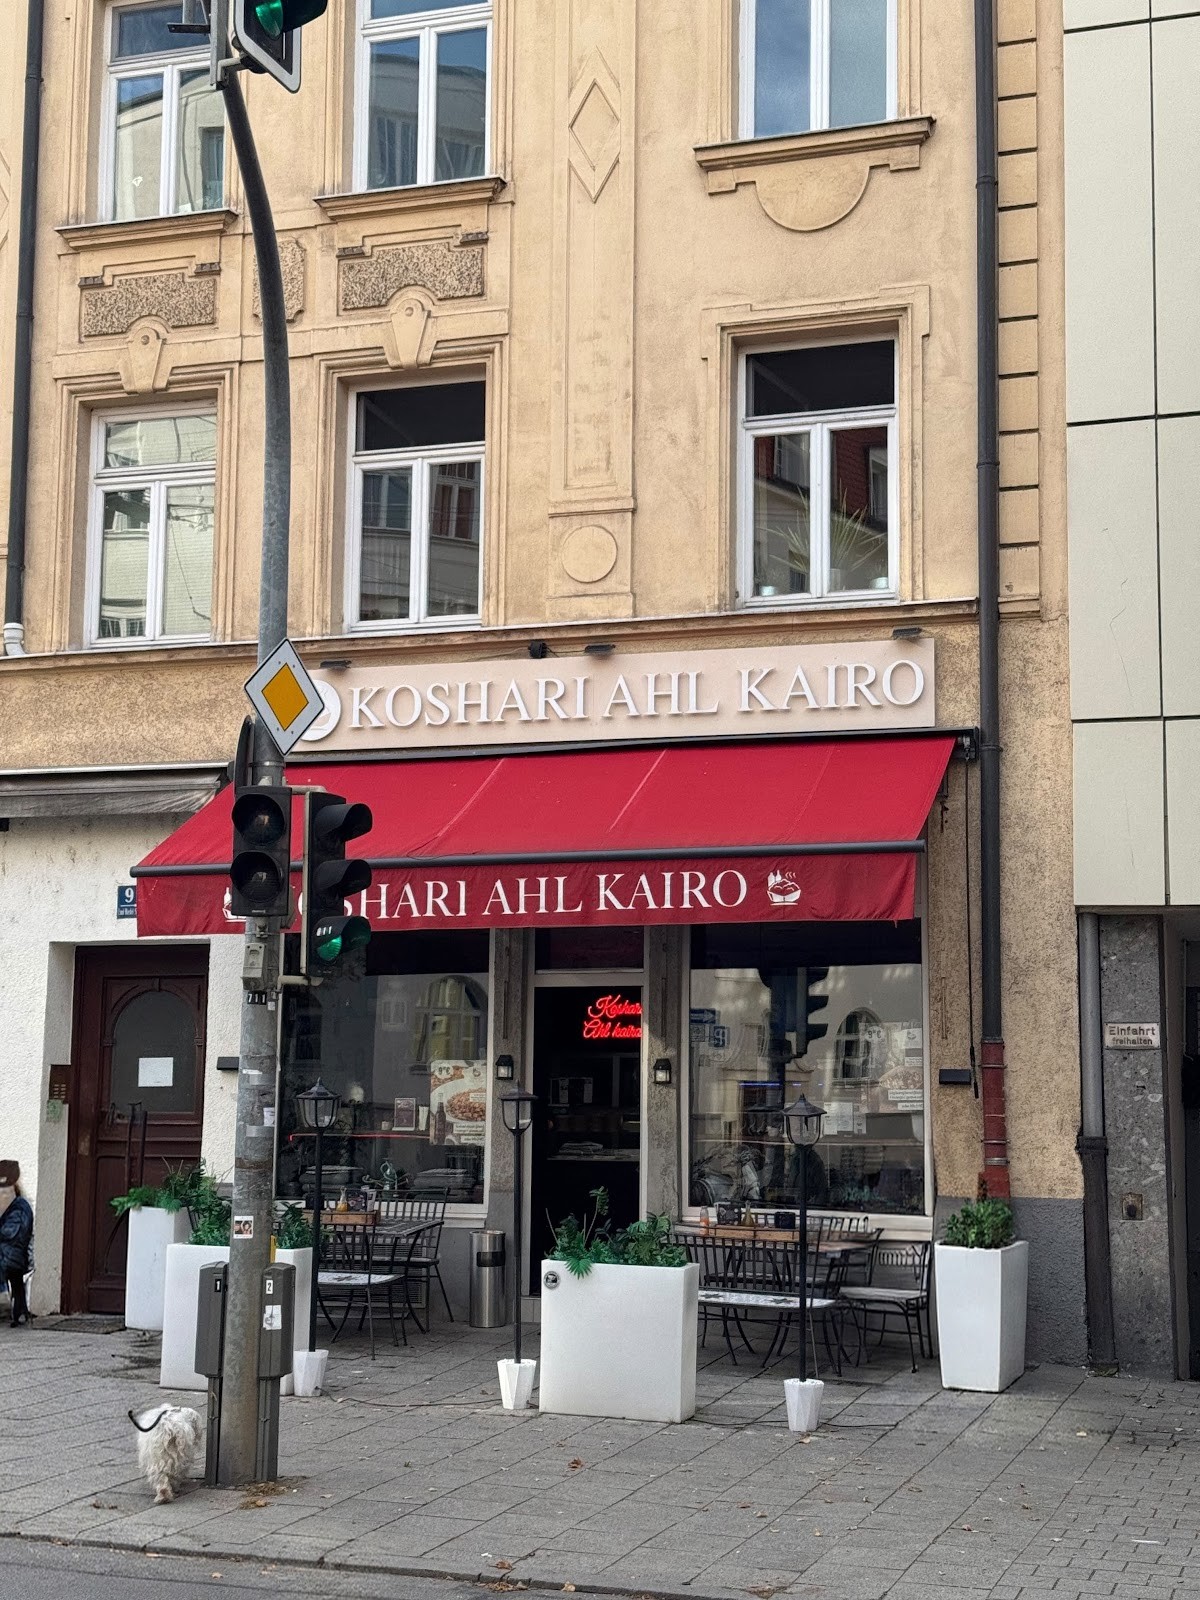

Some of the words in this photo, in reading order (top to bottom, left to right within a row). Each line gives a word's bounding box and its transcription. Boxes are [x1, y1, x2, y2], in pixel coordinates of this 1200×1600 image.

[348, 675, 590, 728] KOSHARI
[601, 670, 720, 718] AHL
[737, 659, 925, 712] KAIRO
[124, 887, 135, 904] 9
[297, 880, 467, 919] HARI
[482, 876, 583, 916] AHL
[596, 869, 748, 911] KAIRO
[247, 993, 266, 1004] 711
[1109, 1026, 1156, 1036] Einfahrt
[1112, 1036, 1153, 1045] freihalten
